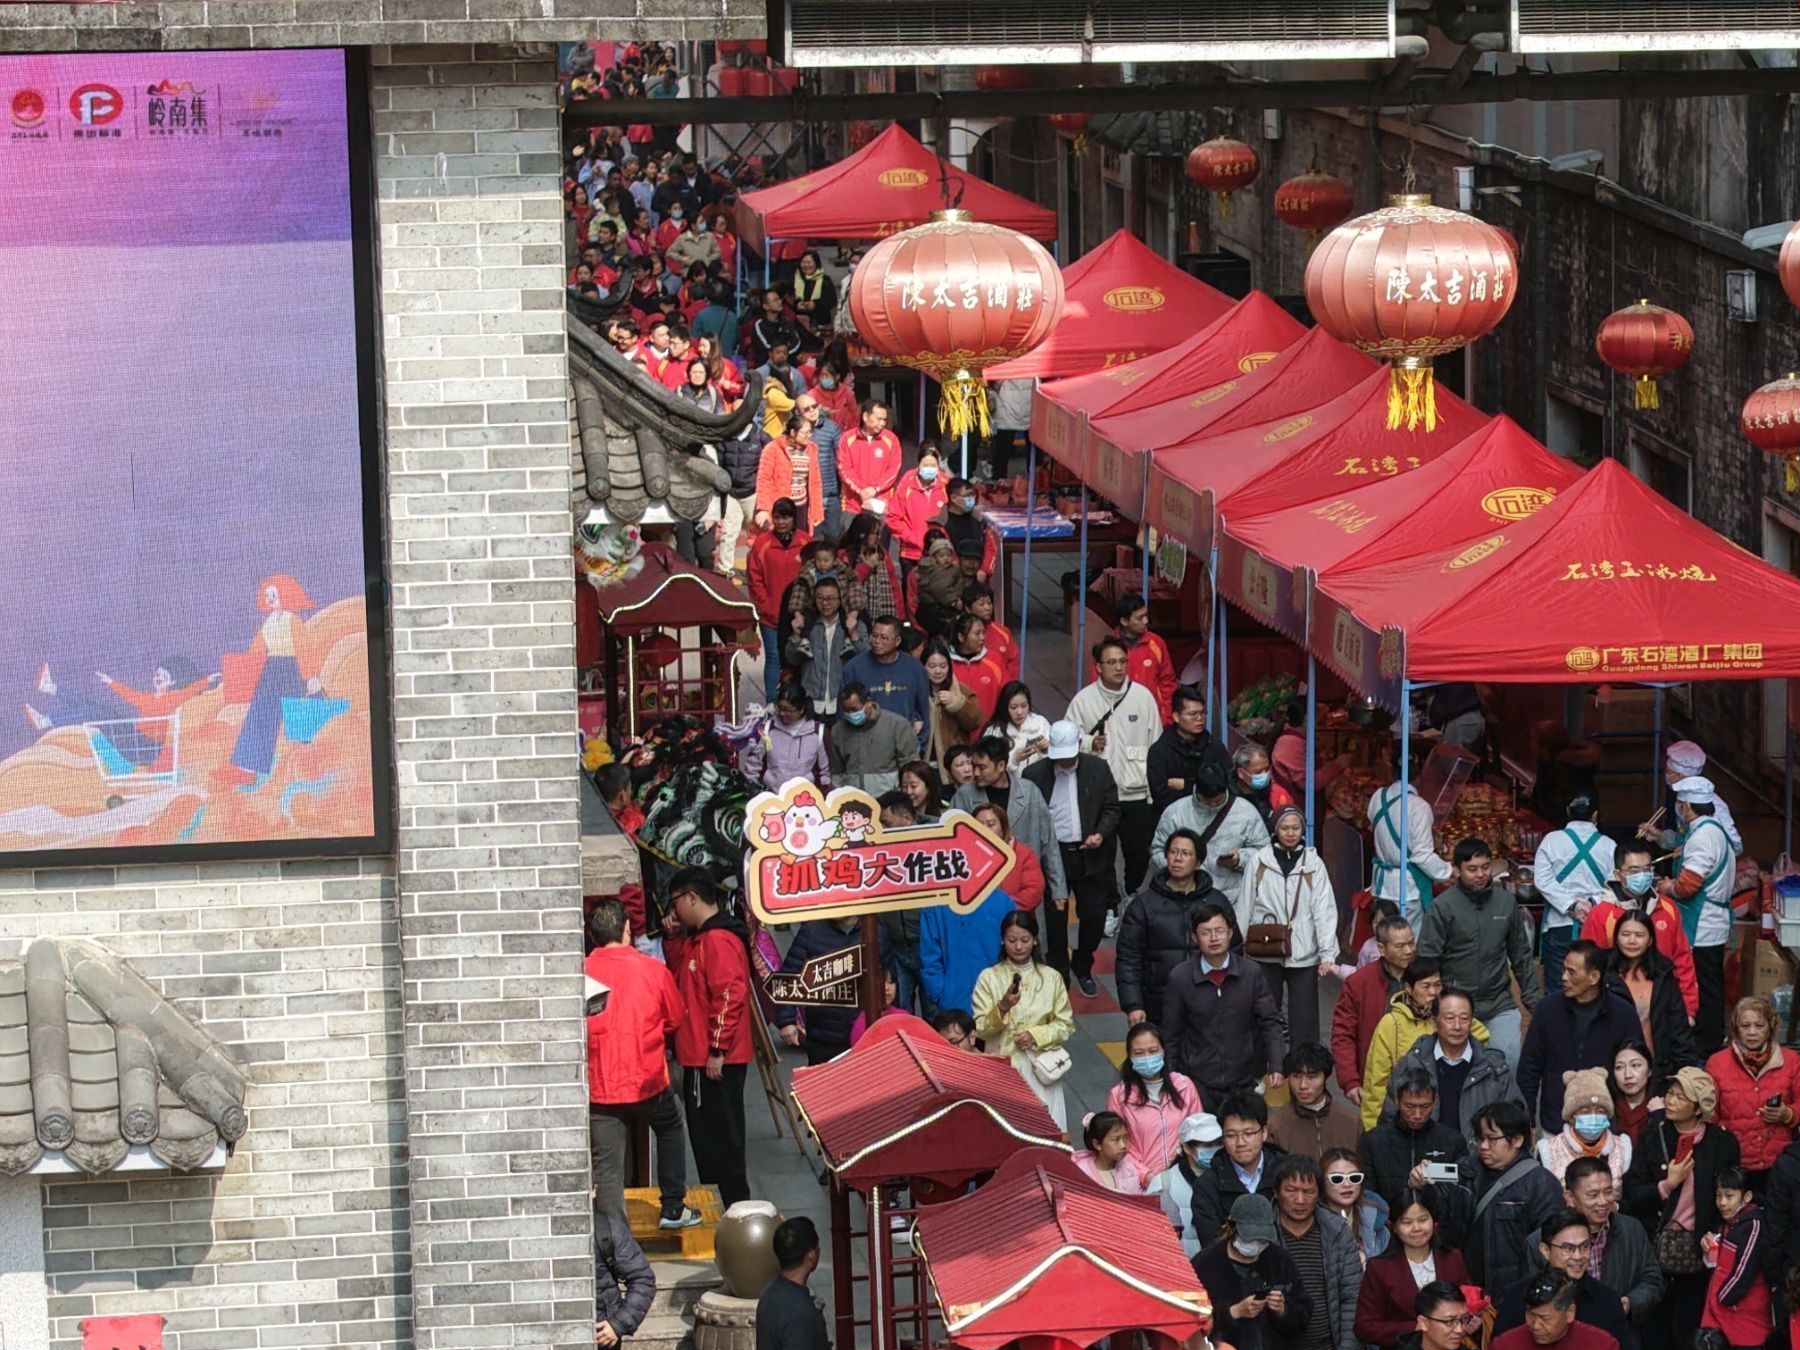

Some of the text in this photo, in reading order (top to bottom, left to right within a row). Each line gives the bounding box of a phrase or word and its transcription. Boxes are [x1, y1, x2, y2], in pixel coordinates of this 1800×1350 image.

[149, 97, 207, 128] 岭南集
[901, 271, 1035, 312] 陳太吉酒莊
[1602, 643, 1763, 664] 广东石湾酒厂集团
[775, 850, 971, 896] 抓鸡大作战
[812, 952, 854, 984] 太吉咖啡
